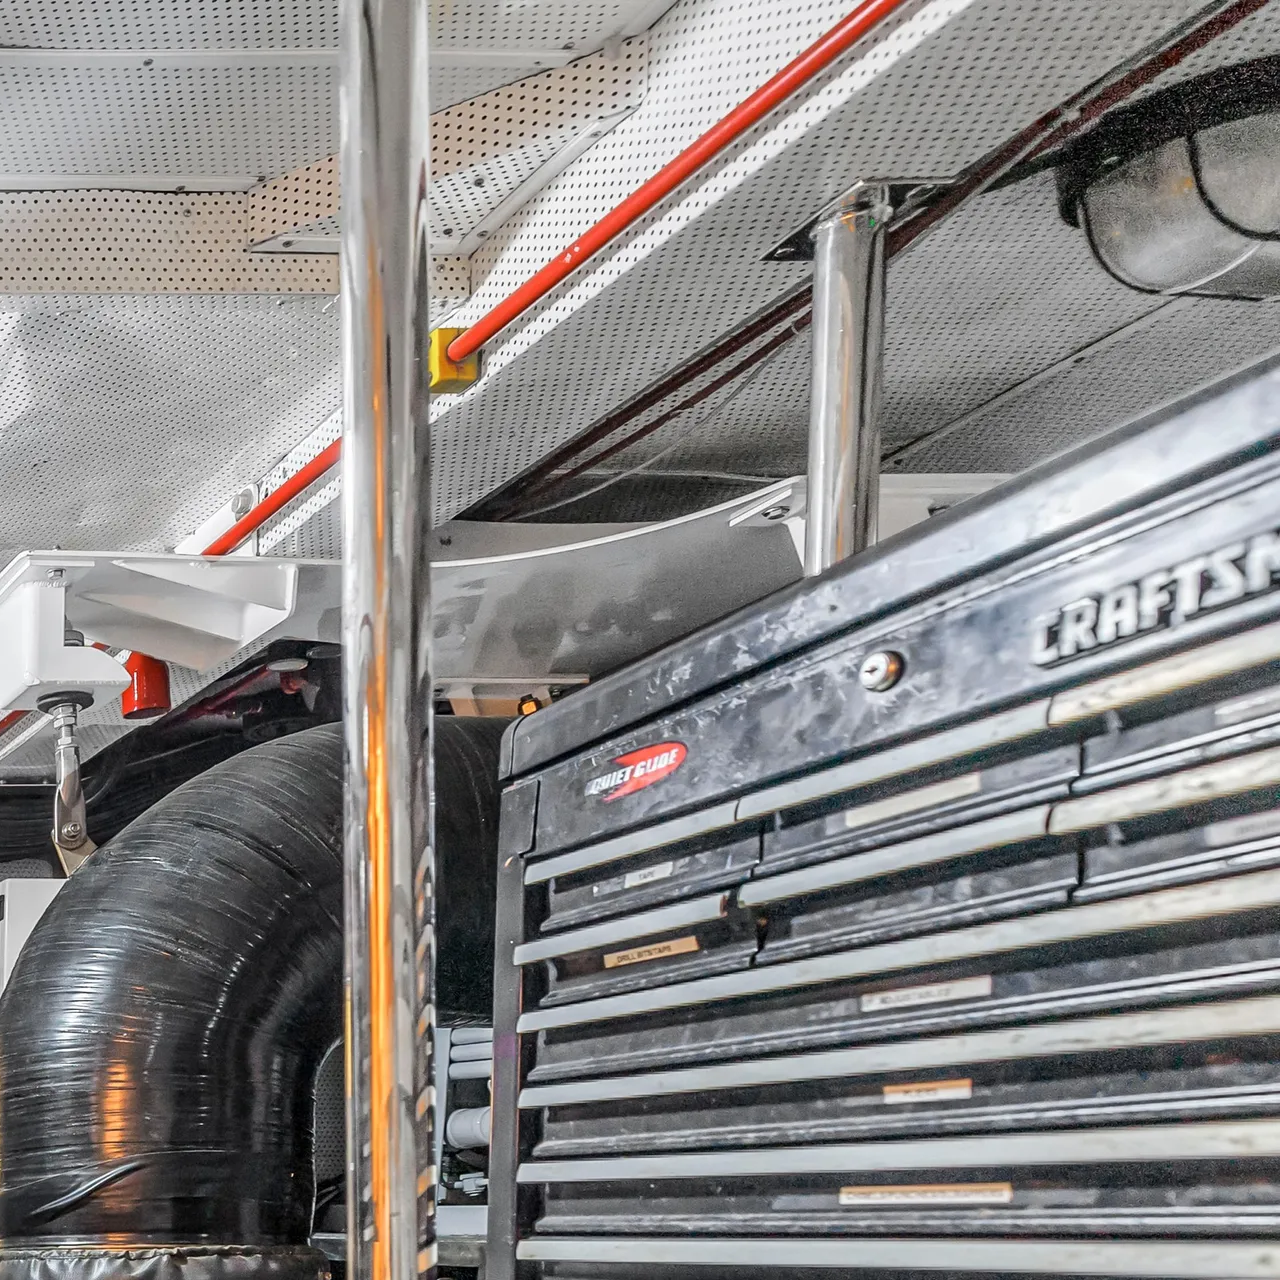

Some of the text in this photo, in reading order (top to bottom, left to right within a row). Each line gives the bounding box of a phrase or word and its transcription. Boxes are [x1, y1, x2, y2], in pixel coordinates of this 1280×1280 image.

[1033, 530, 1280, 665] CRAFTSM
[588, 748, 679, 795] QUIET GLIDE
